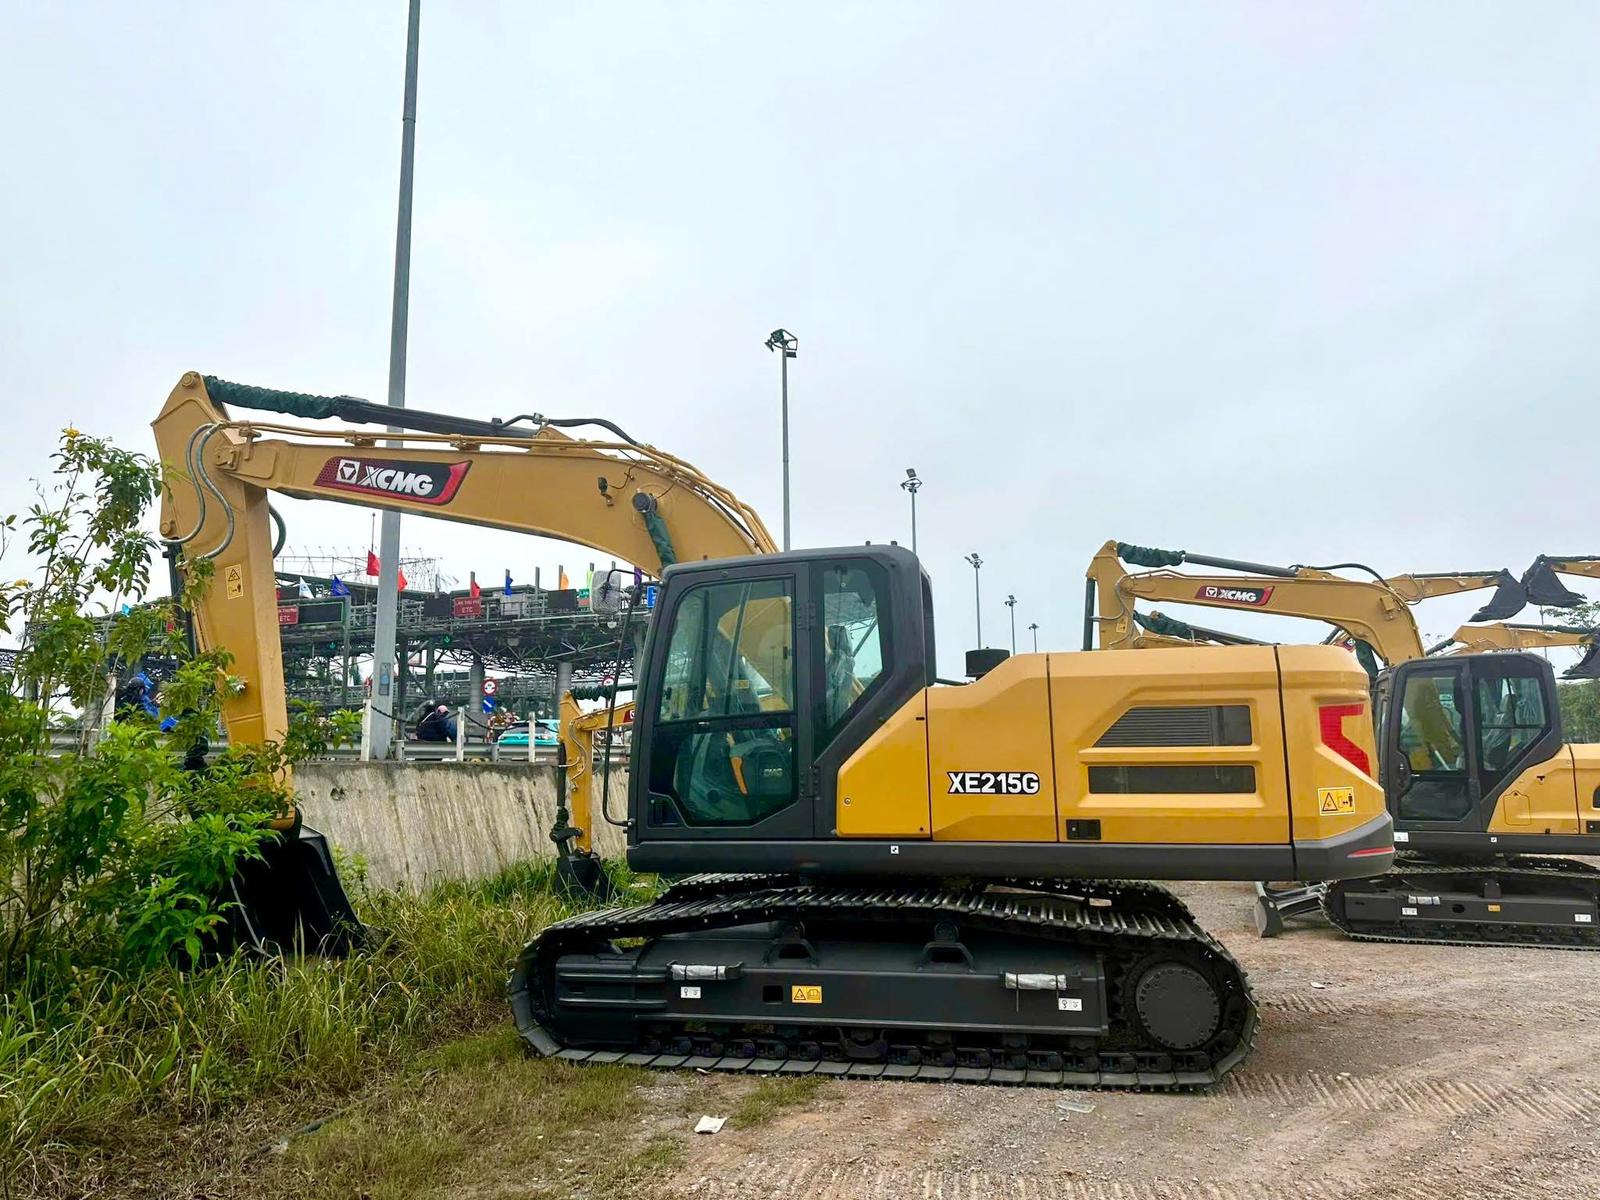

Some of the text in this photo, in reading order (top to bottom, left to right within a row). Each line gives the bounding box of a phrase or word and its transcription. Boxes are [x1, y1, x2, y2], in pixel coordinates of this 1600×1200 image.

[358, 466, 433, 496] XCMG
[1217, 589, 1257, 602] XCMG
[947, 772, 1039, 794] XE215G
